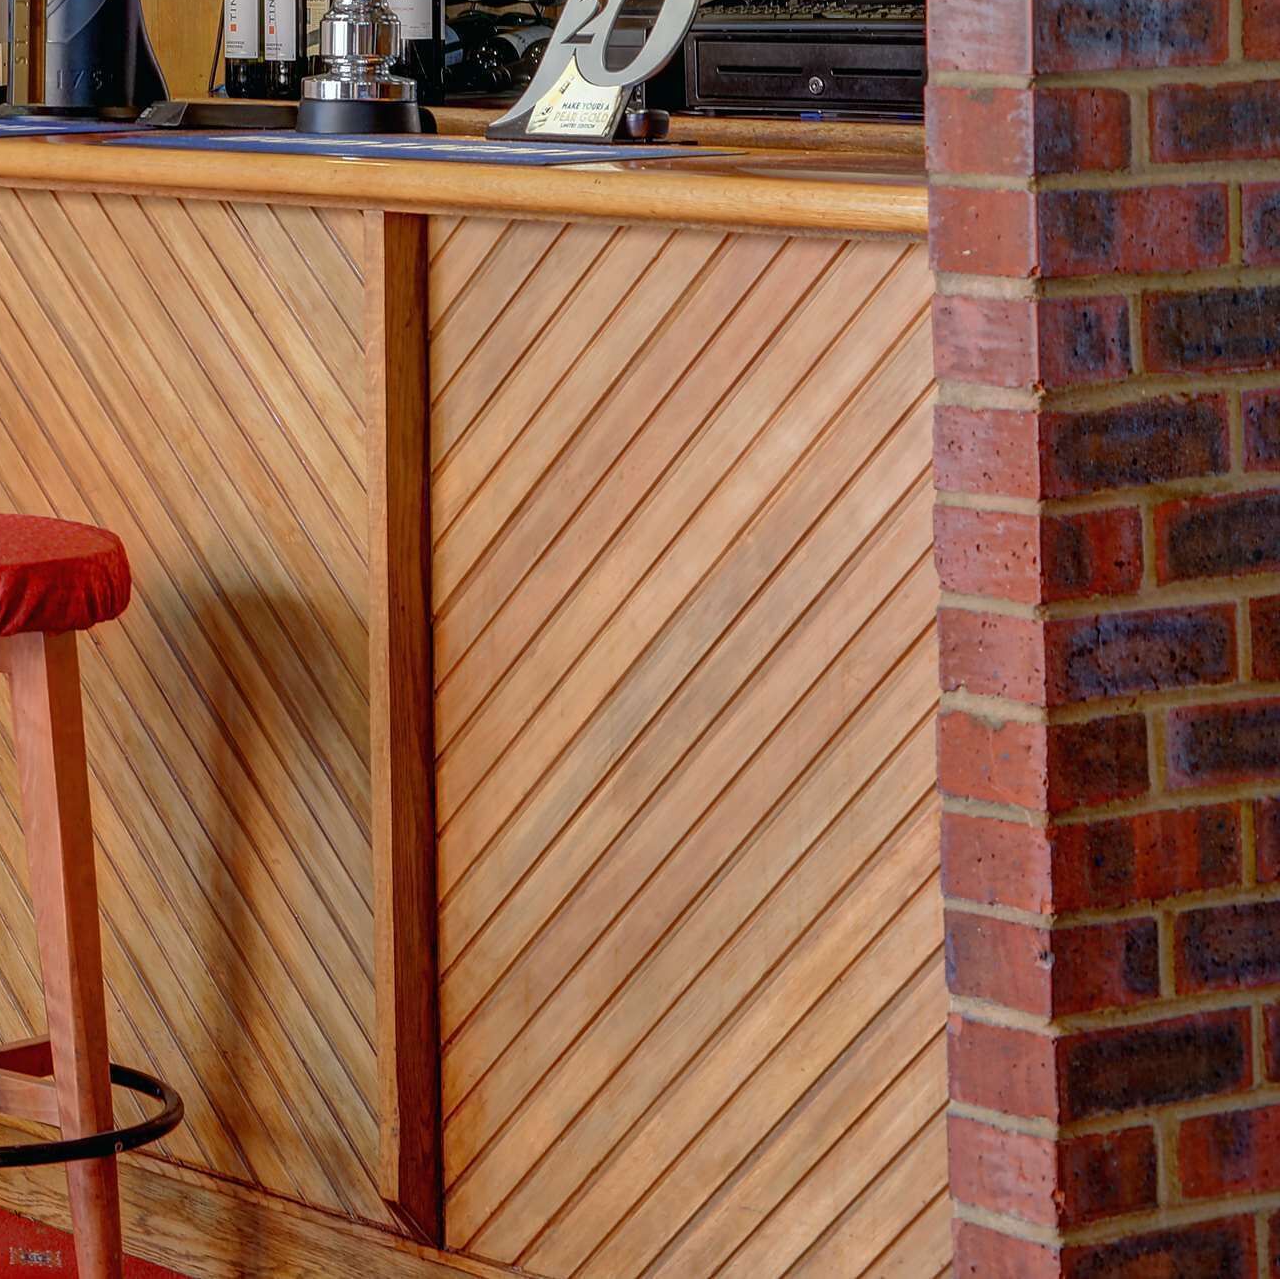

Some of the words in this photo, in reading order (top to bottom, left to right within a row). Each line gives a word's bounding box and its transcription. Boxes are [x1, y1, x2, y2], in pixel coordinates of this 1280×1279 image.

[562, 101, 581, 110] MAKE
[553, 110, 578, 122] PEAR
[580, 111, 609, 123] GOLD
